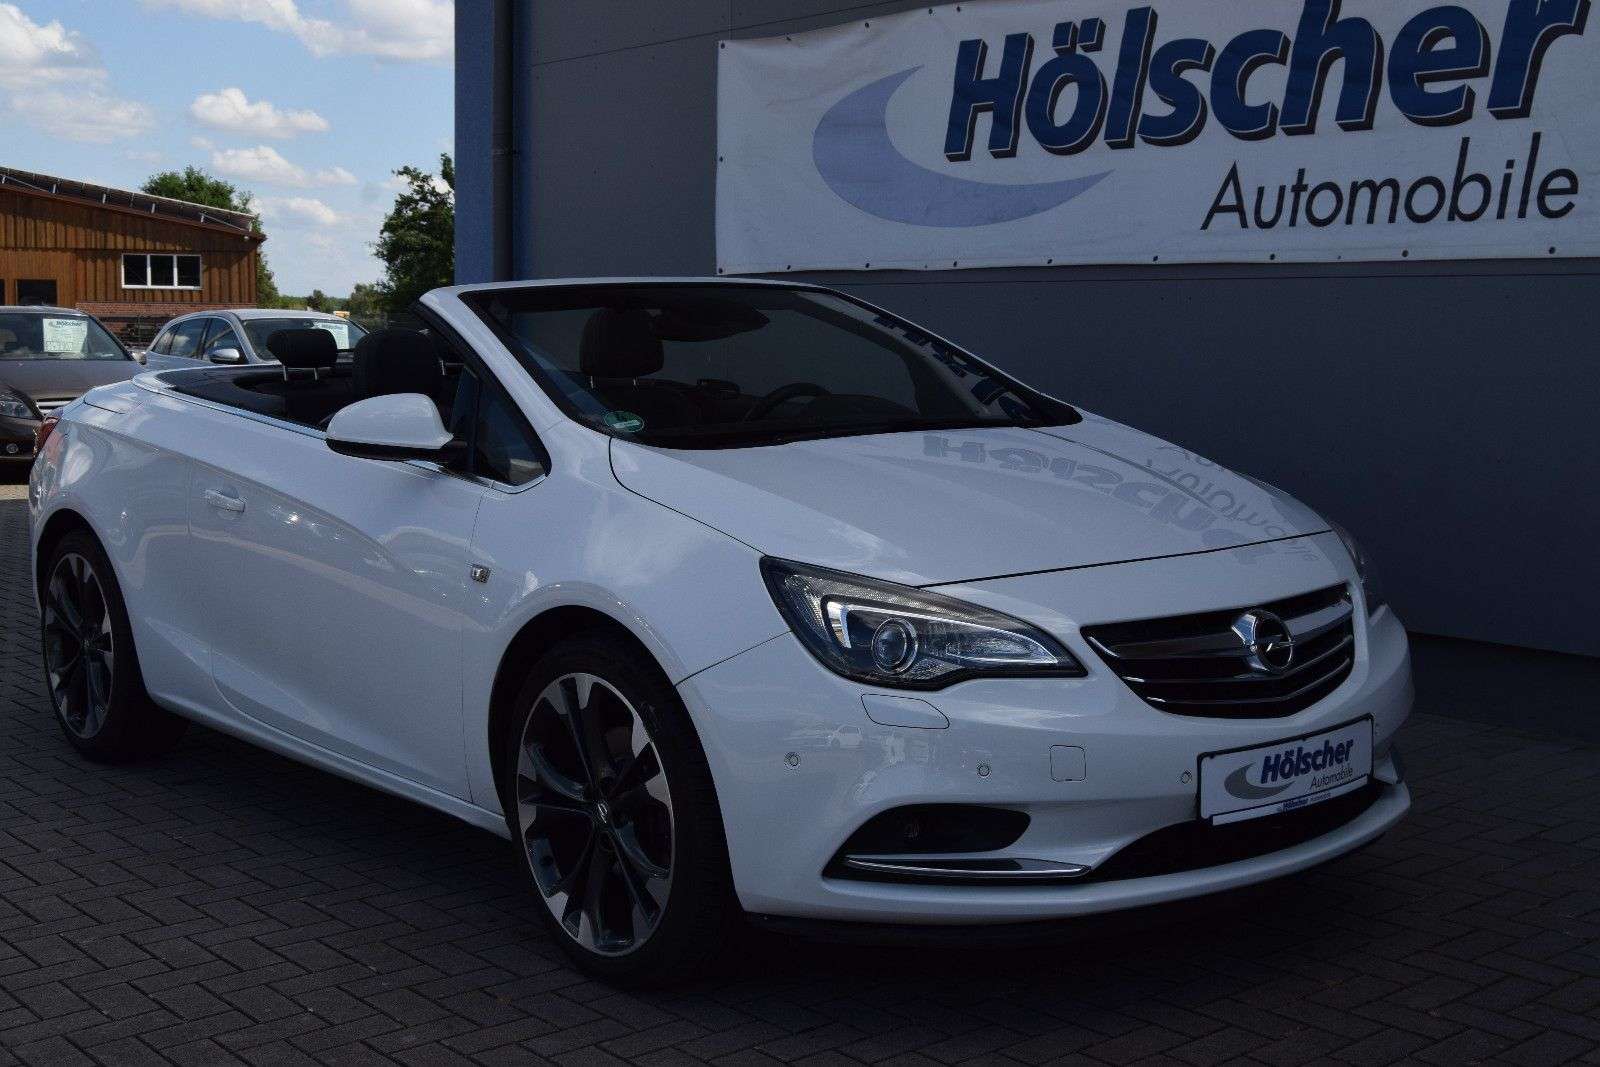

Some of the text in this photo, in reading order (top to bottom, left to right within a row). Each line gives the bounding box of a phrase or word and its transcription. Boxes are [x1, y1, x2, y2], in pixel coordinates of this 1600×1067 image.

[943, 0, 1588, 162] Hölscher
[1200, 131, 1579, 231] Automobile
[1261, 739, 1353, 784] Hölscher
[1310, 765, 1353, 789] Automobile
